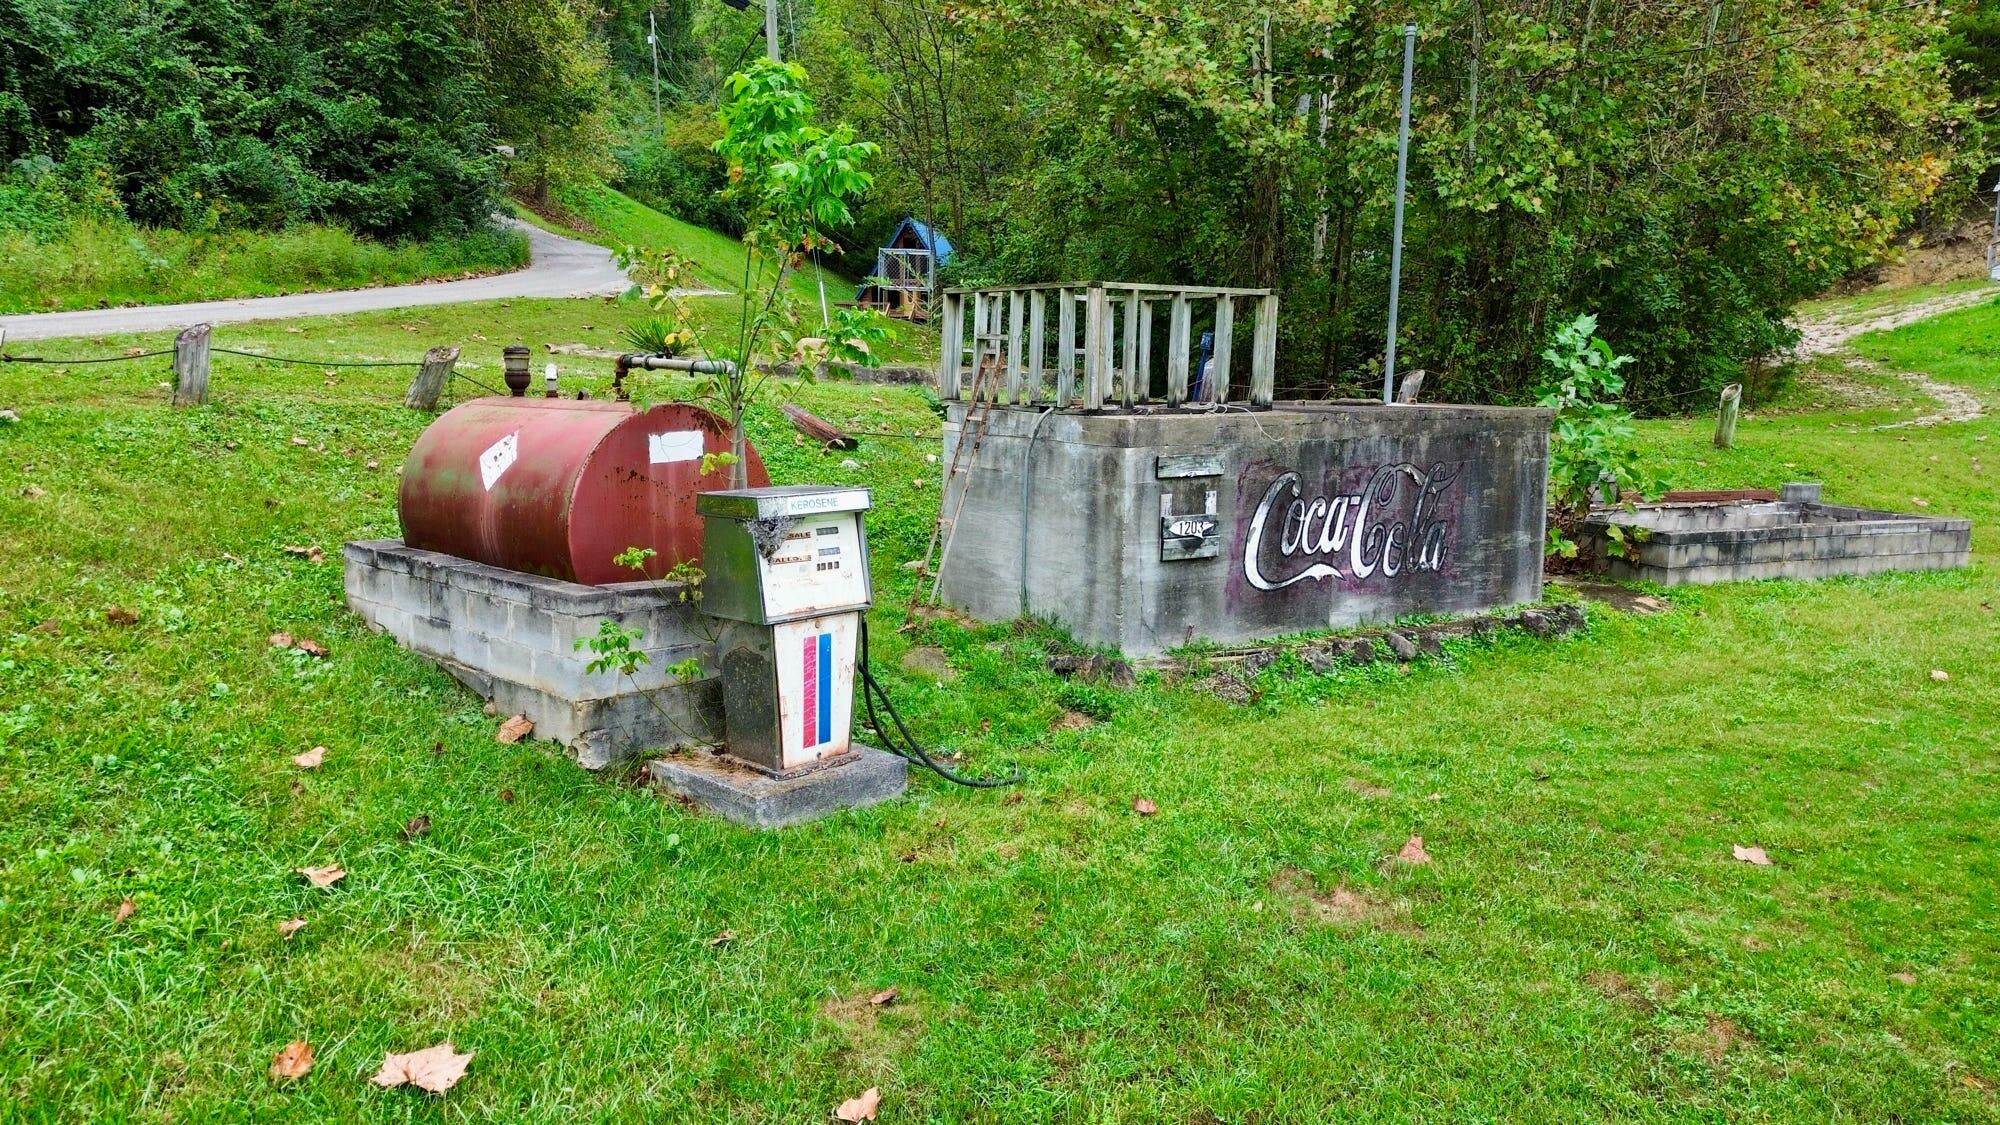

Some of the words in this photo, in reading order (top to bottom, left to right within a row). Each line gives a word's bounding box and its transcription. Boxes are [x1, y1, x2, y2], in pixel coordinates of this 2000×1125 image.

[790, 498, 839, 511] KEROSENE
[1179, 521, 1204, 535] 1203
[1243, 461, 1464, 591] Coca-Cola
